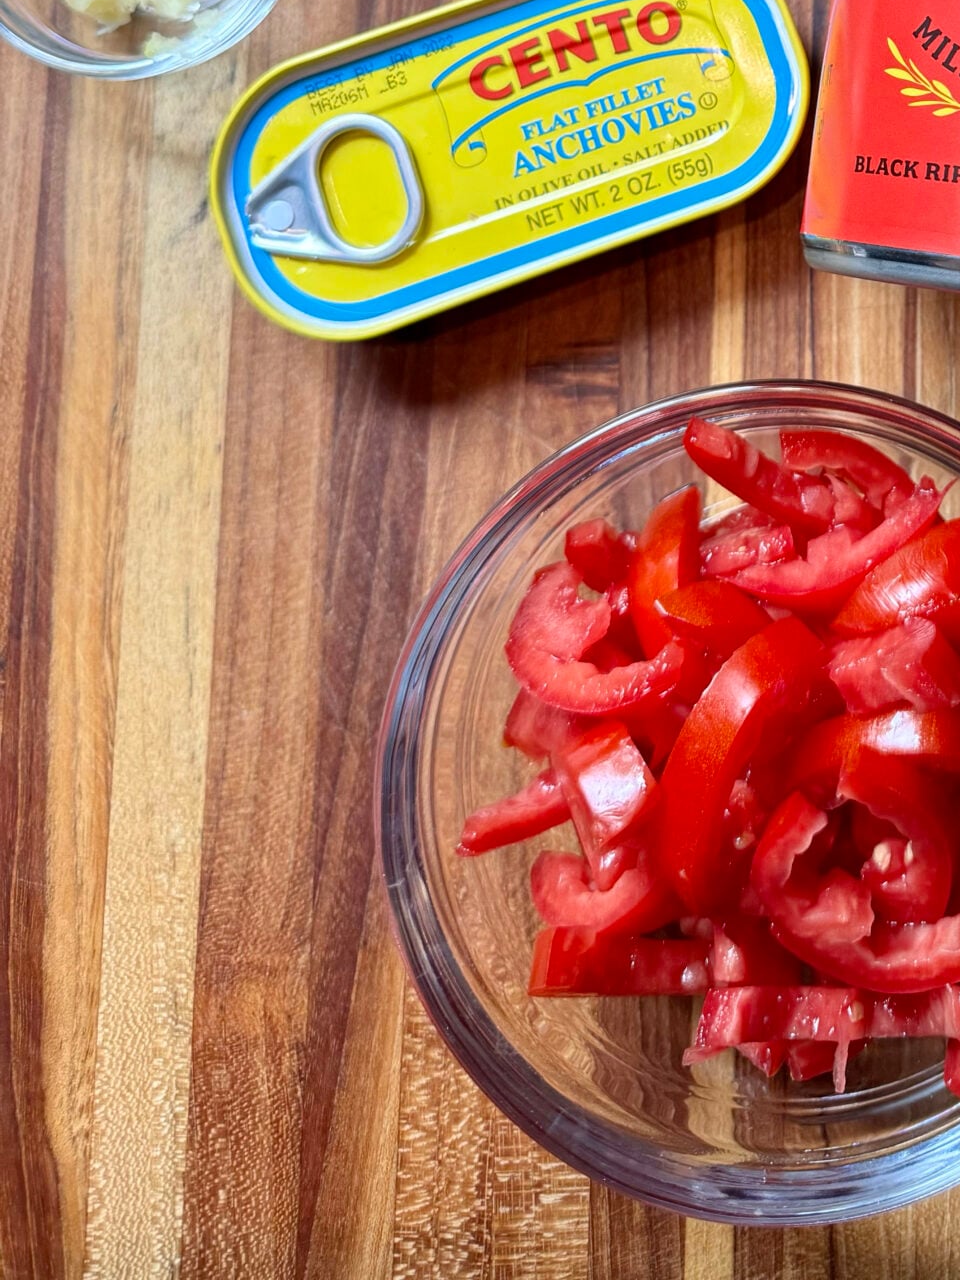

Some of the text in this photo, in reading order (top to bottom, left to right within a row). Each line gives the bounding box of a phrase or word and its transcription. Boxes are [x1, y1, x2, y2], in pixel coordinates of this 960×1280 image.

[304, 72, 344, 100] BEST
[354, 62, 375, 84] BY
[386, 47, 416, 72] JAN
[520, 77, 667, 141] FLAT FILLET
[494, 119, 730, 211] IN OLIVE OIL SALT ADDED
[513, 91, 697, 178] ANCHOVIES
[853, 155, 919, 179] BLACK
[525, 152, 714, 232] NET WT. 2 OZ. (55g)
